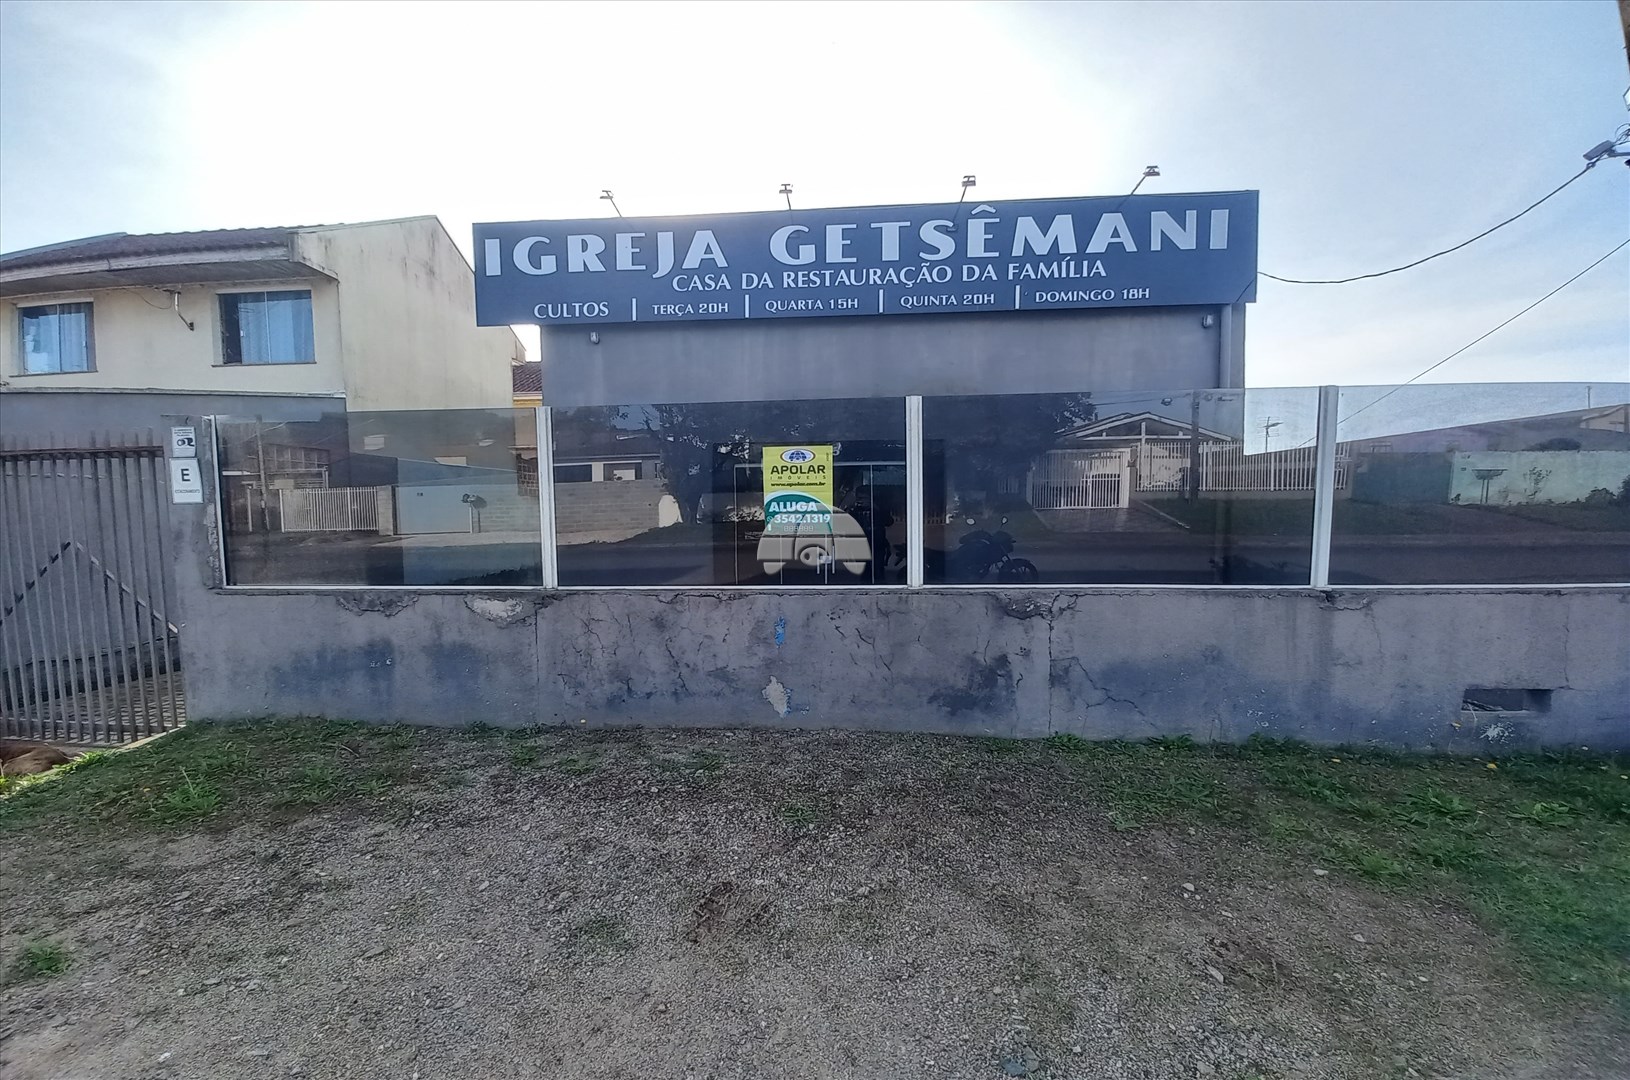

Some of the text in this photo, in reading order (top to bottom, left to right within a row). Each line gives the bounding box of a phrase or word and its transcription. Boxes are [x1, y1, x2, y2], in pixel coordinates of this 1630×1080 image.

[485, 205, 1229, 278] IGREJA GETSÊMANI
[672, 256, 1107, 292] CASA DA RESTAURAÇÃO DA FAMÍLIA
[900, 293, 995, 307] QUINTA 20H
[1036, 288, 1150, 303] DOMINGO 18H
[533, 302, 609, 319] CULTOS
[652, 302, 728, 316] TERÇA 20H
[765, 298, 858, 312] QUARTA 15H
[180, 468, 191, 482] E
[770, 465, 826, 475] APOLAR
[768, 501, 818, 512] ALUGA
[774, 514, 830, 524] 3542.1319
